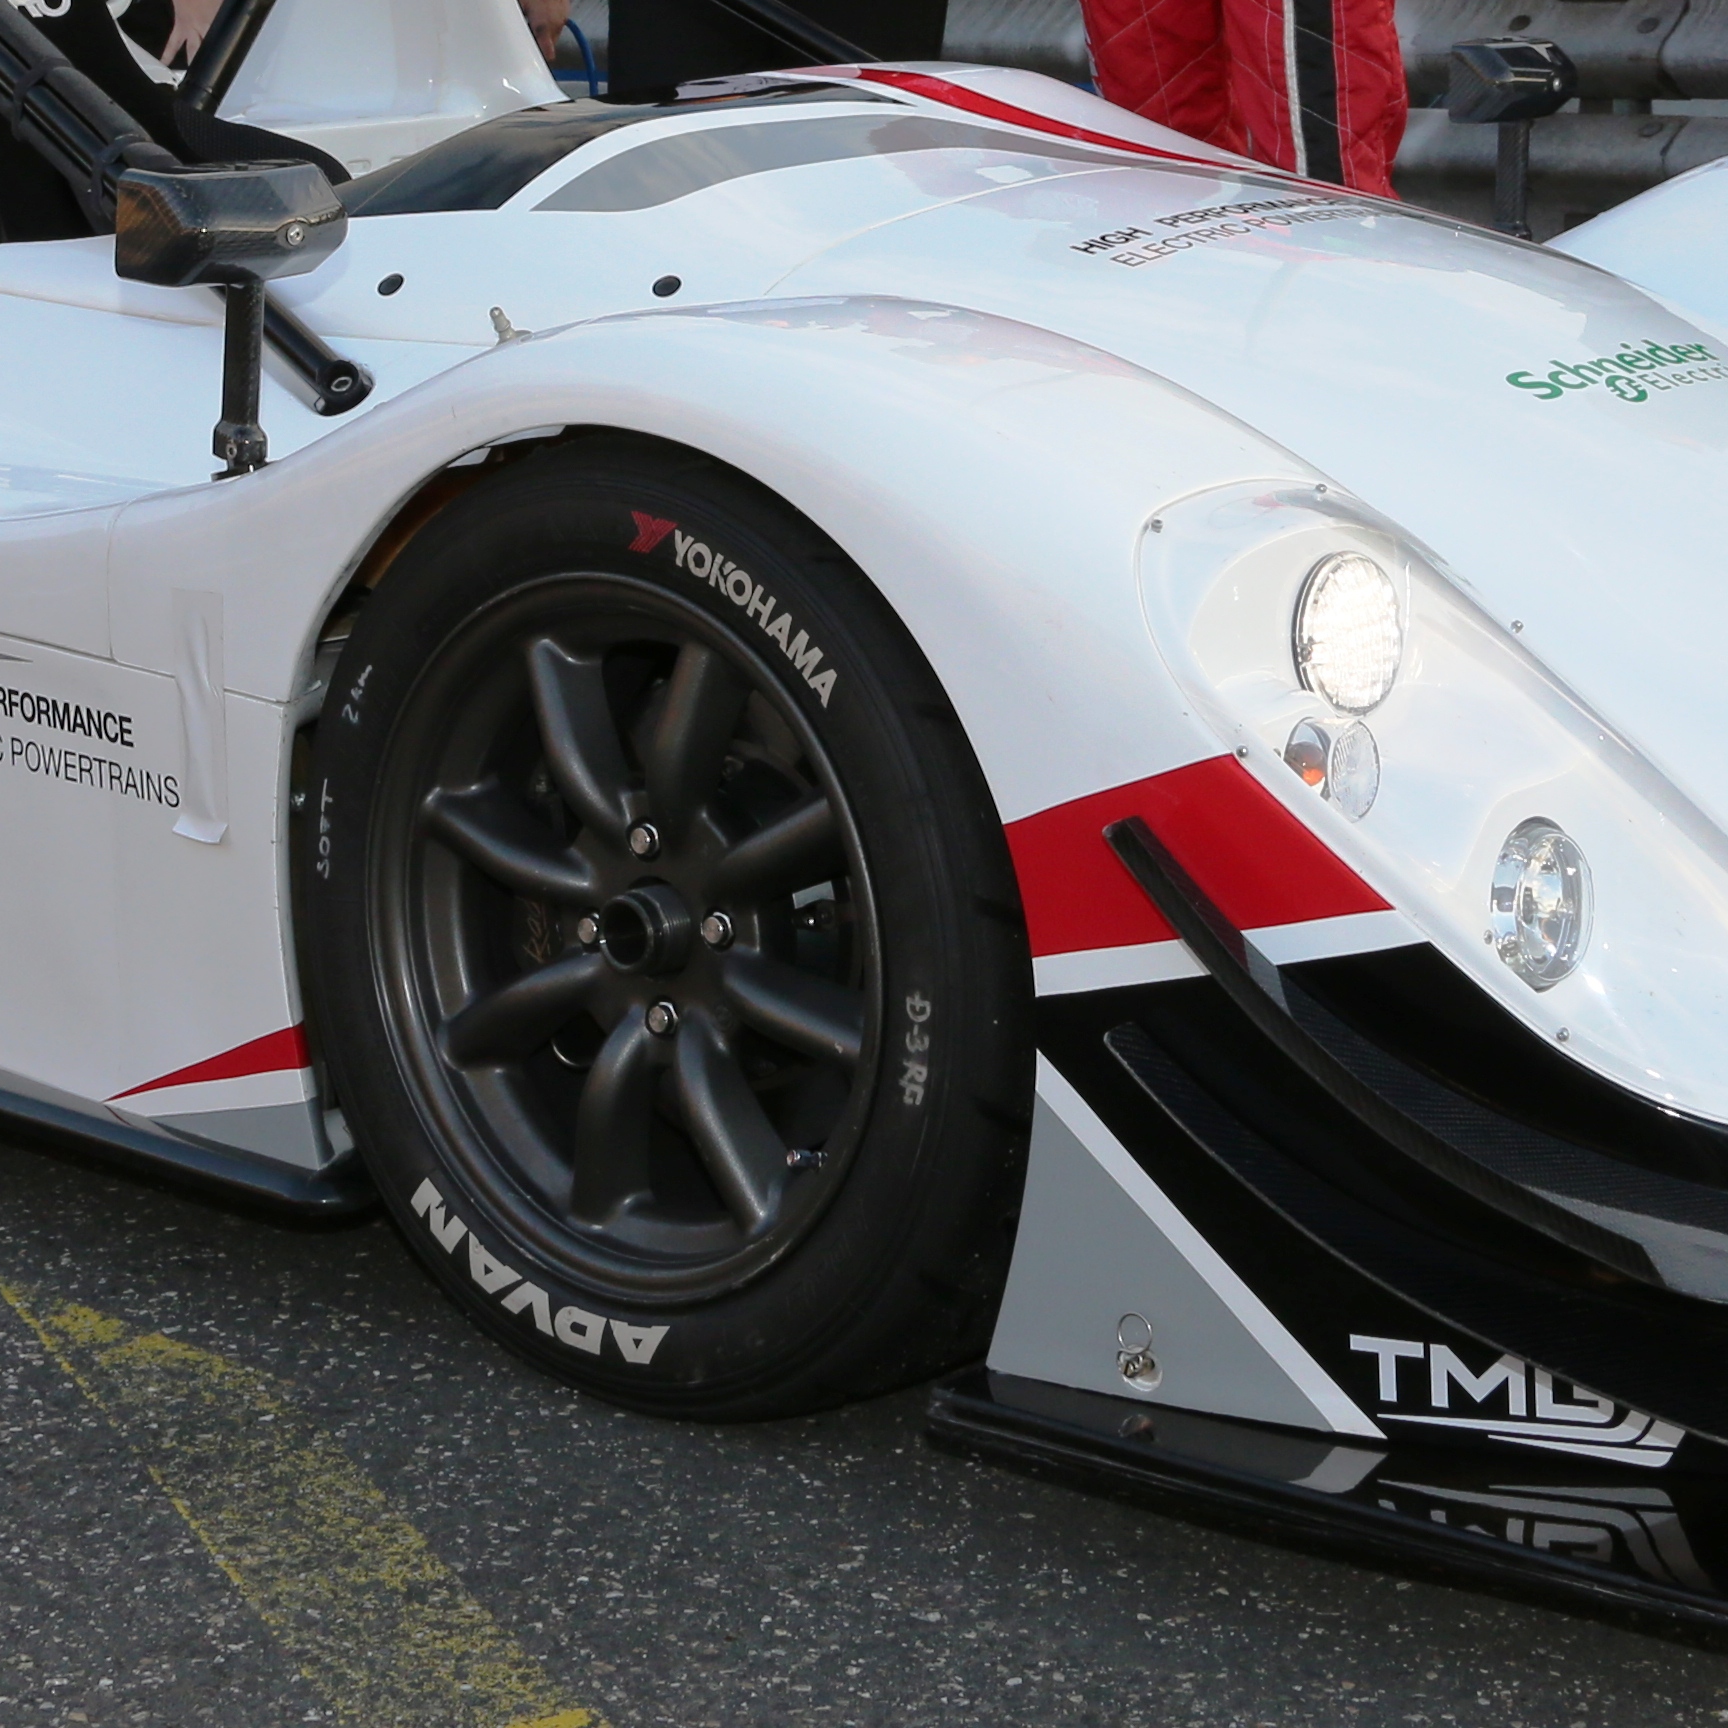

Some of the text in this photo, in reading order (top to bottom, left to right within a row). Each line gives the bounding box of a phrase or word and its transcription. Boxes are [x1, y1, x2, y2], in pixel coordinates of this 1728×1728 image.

[1069, 226, 1154, 257] HIGH
[1109, 222, 1252, 269] ELECTRIC
[1505, 339, 1720, 400] Schneider
[673, 529, 840, 710] YOKOHAMA
[10, 736, 181, 808] POWERTRAINS
[411, 1176, 670, 1366] ADVAN
